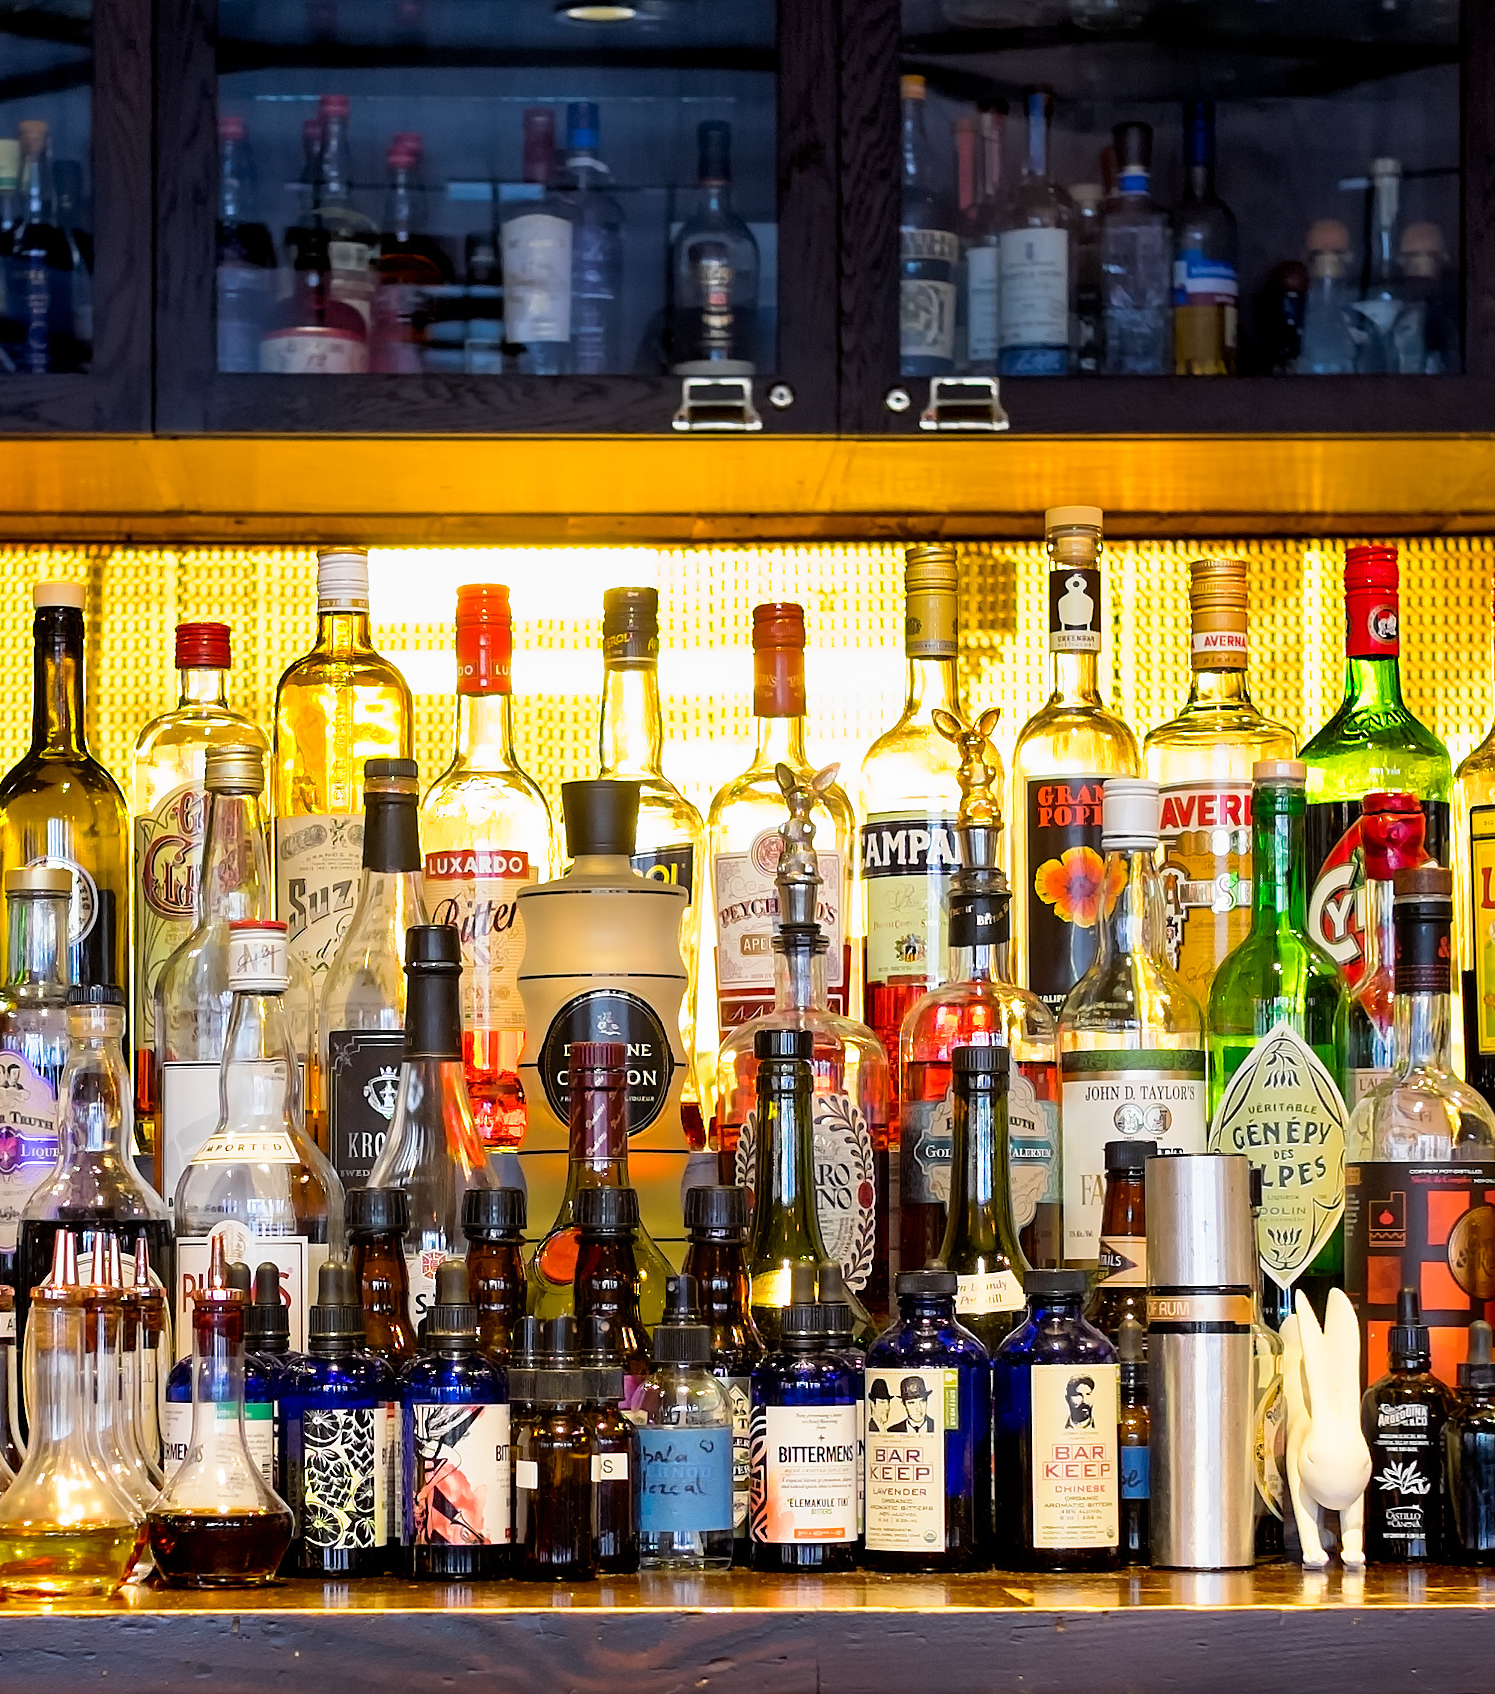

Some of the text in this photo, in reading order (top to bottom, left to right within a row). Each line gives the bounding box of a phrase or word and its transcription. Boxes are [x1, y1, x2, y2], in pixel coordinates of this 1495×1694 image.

[1203, 636, 1246, 648] AVERNA
[1160, 794, 1254, 830] AVER
[428, 855, 524, 875] LUXARDO
[718, 896, 838, 929] PEYCHD'S
[557, 1070, 657, 1087] CON
[1084, 1084, 1196, 1102] JOHN D. TAYLOR'S
[1247, 1102, 1318, 1116] VÉRITABLE
[10, 1111, 54, 1130] TRUTH
[1232, 1116, 1333, 1151] GÉNÉPY
[20, 1145, 58, 1159] LIQUE
[347, 1130, 382, 1159] KRO
[925, 1145, 953, 1159] GOL
[1273, 1148, 1295, 1162] DES
[1158, 1301, 1191, 1317] RUM
[778, 1445, 854, 1464] BITTERMENS
[875, 1448, 921, 1463] BAR
[1054, 1445, 1106, 1460] BAR
[602, 1459, 614, 1474] S
[870, 1465, 931, 1481] KEEP
[1044, 1463, 1111, 1479] KEEP
[872, 1487, 927, 1496] LAVENDER
[1055, 1484, 1106, 1493] CHINESE
